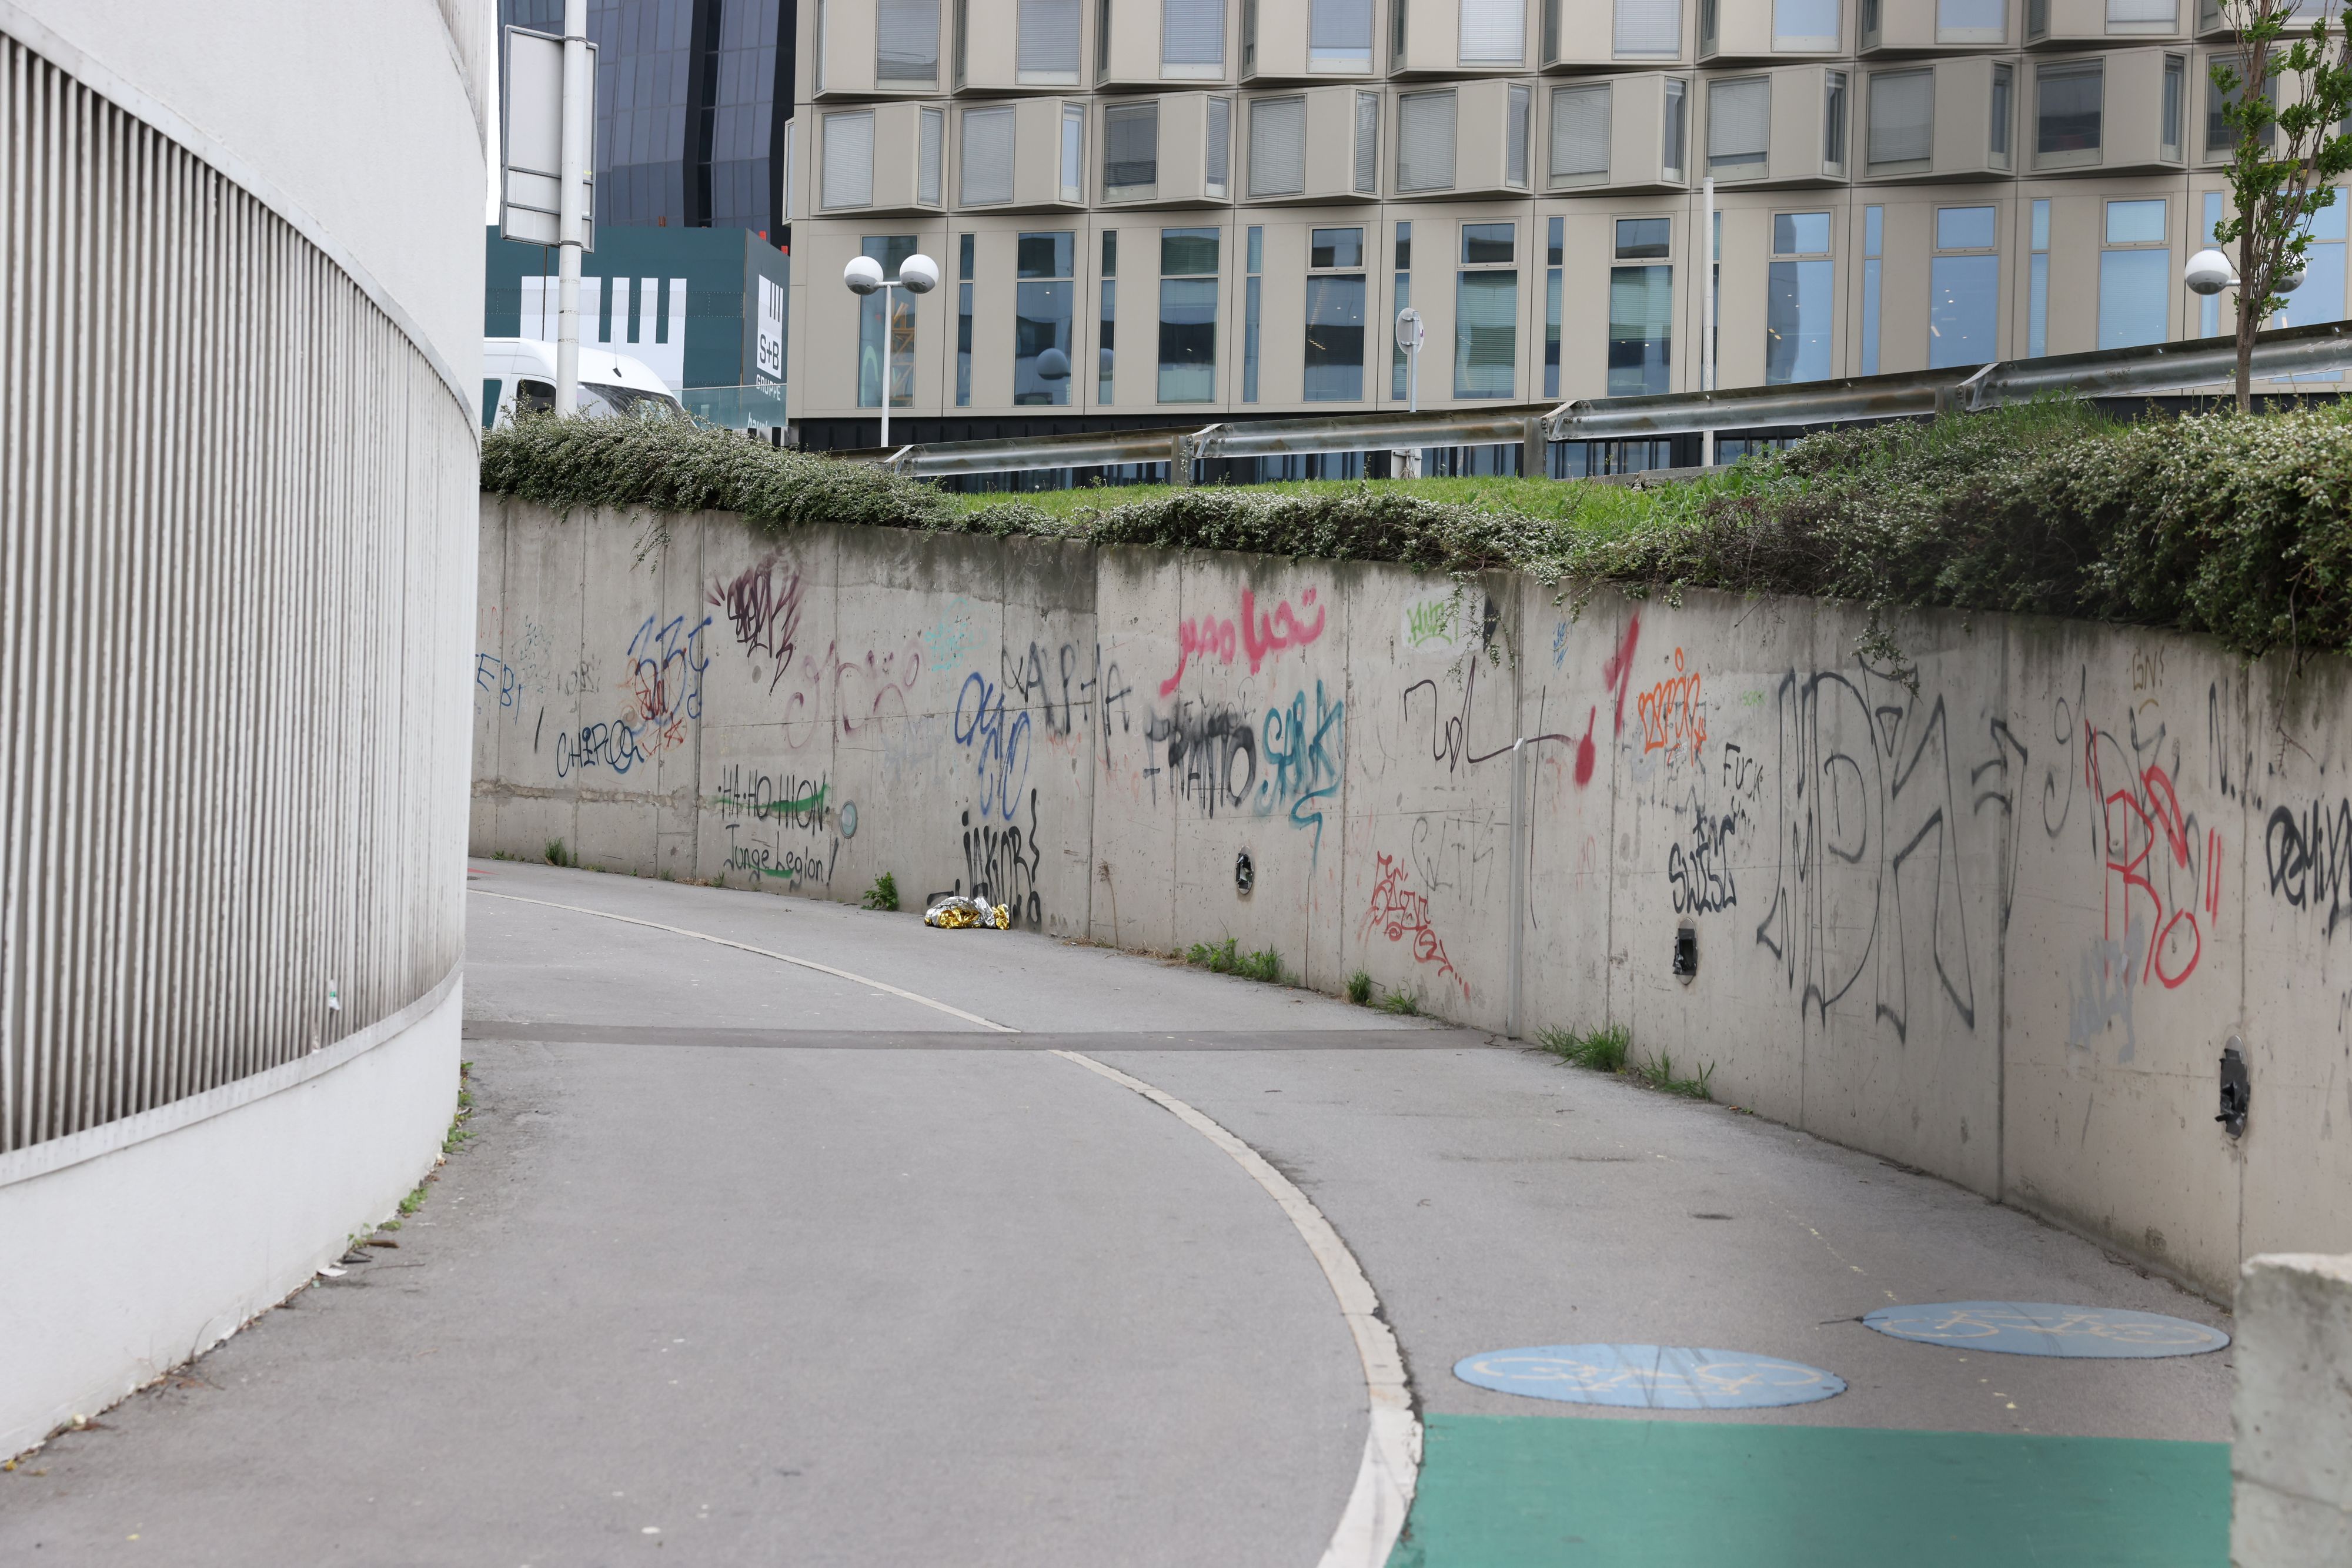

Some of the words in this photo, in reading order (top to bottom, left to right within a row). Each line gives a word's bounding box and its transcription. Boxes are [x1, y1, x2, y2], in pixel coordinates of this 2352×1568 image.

[760, 333, 779, 371] S+B
[756, 373, 781, 402] GRUPPE
[1723, 741, 1763, 803] FUCK
